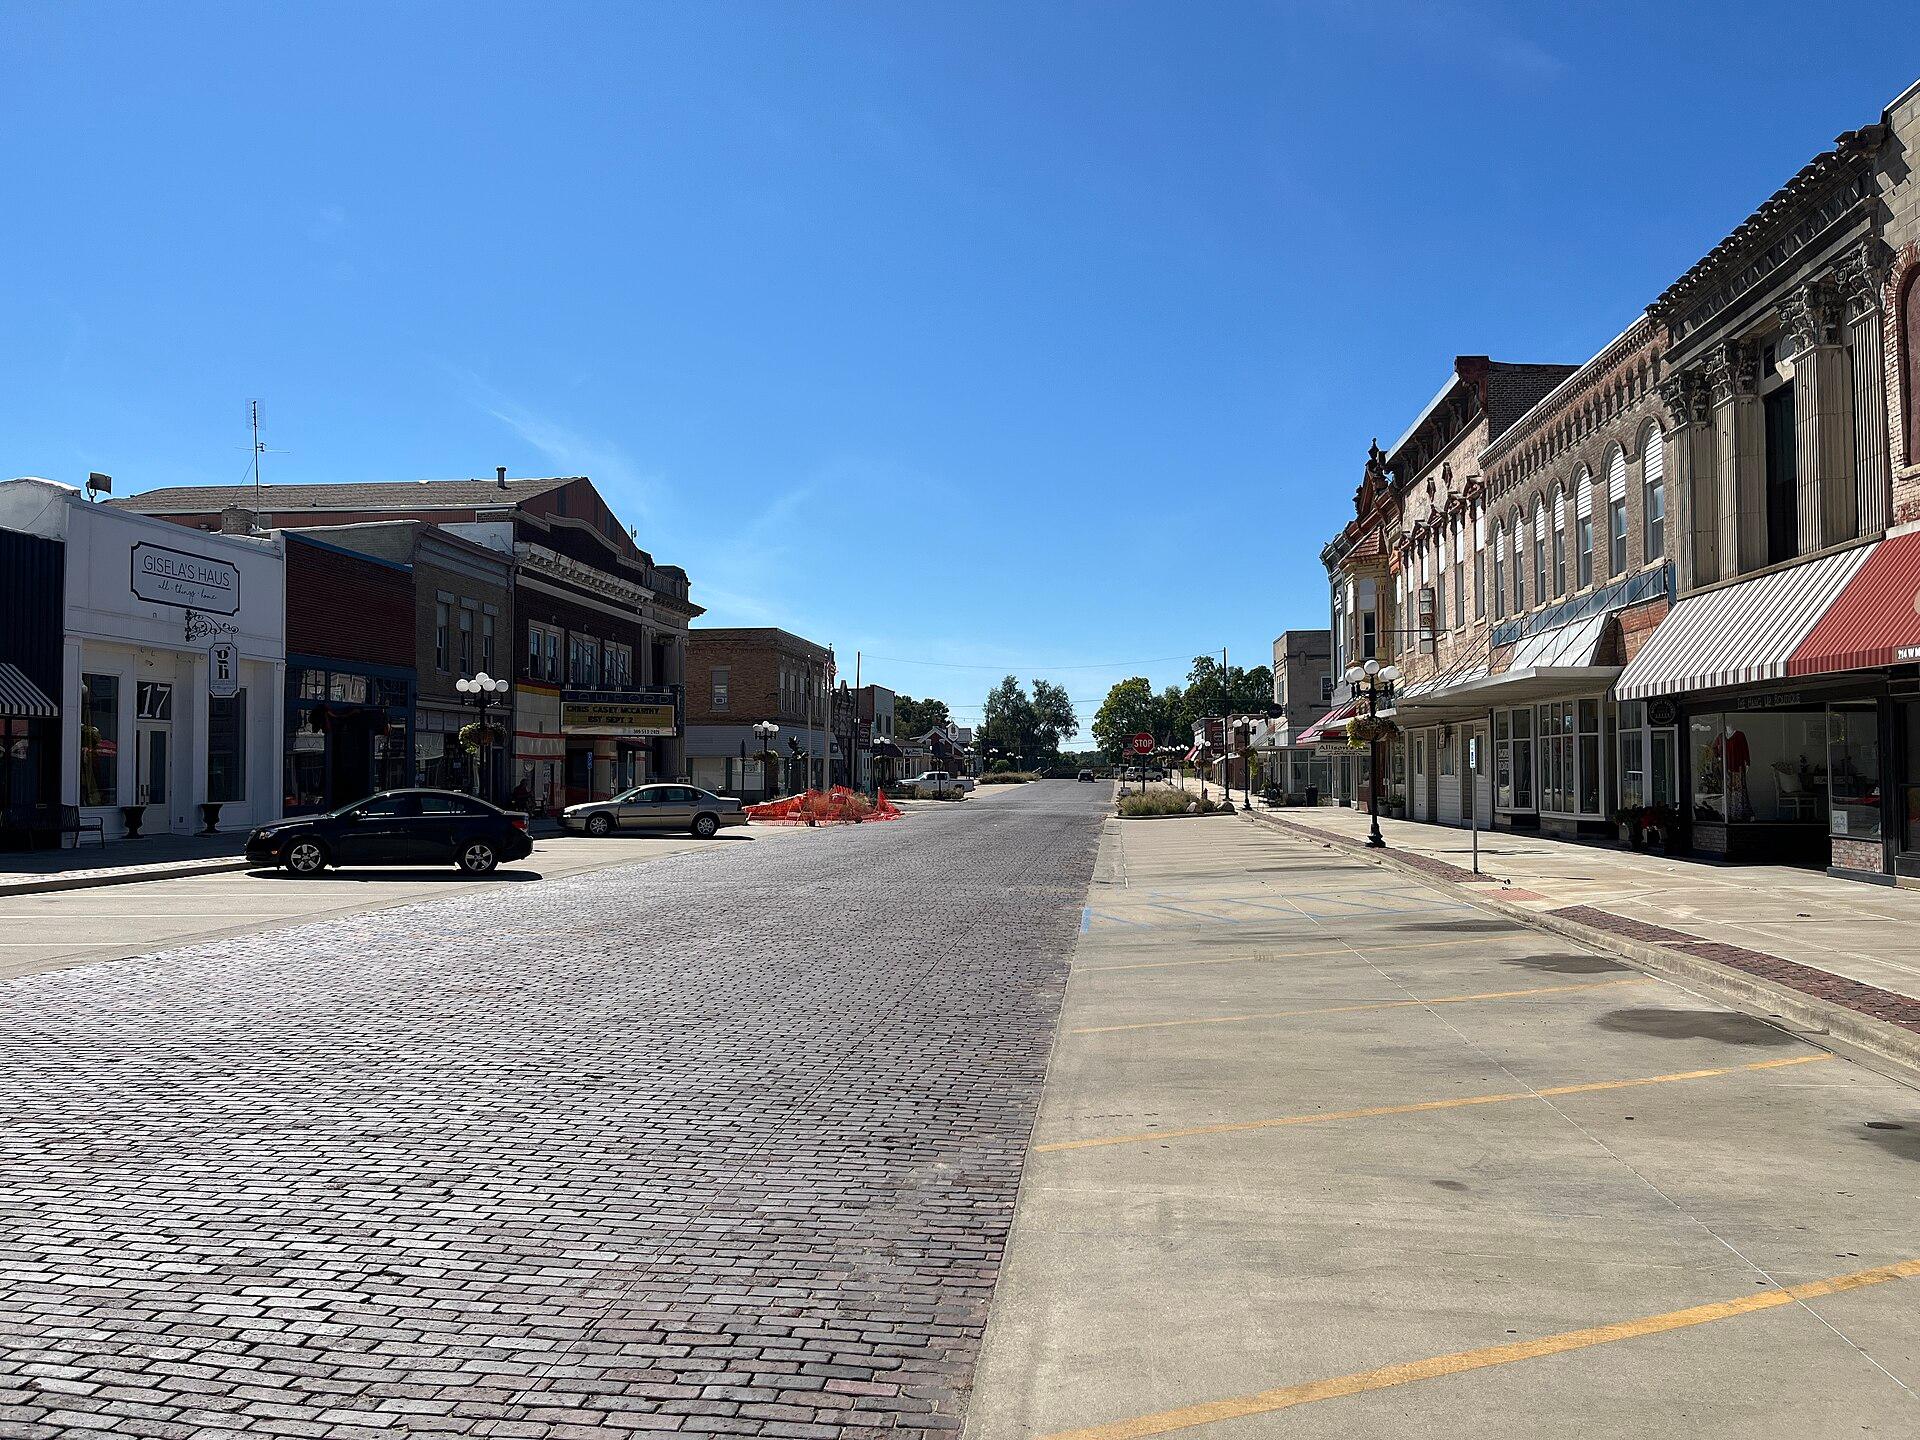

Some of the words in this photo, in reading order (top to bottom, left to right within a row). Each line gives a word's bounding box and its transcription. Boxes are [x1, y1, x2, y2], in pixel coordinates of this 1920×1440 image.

[143, 555, 195, 580] GISELA'S
[198, 566, 230, 587] HAUS
[175, 583, 196, 604] things
[200, 589, 217, 600] home
[138, 683, 171, 719] 17
[566, 693, 670, 703] LAWFORD
[566, 705, 590, 713] CHRIS
[592, 706, 619, 714] CASEY
[605, 716, 626, 724] SEPT
[628, 716, 634, 724] 2
[1133, 739, 1153, 748] STOP
